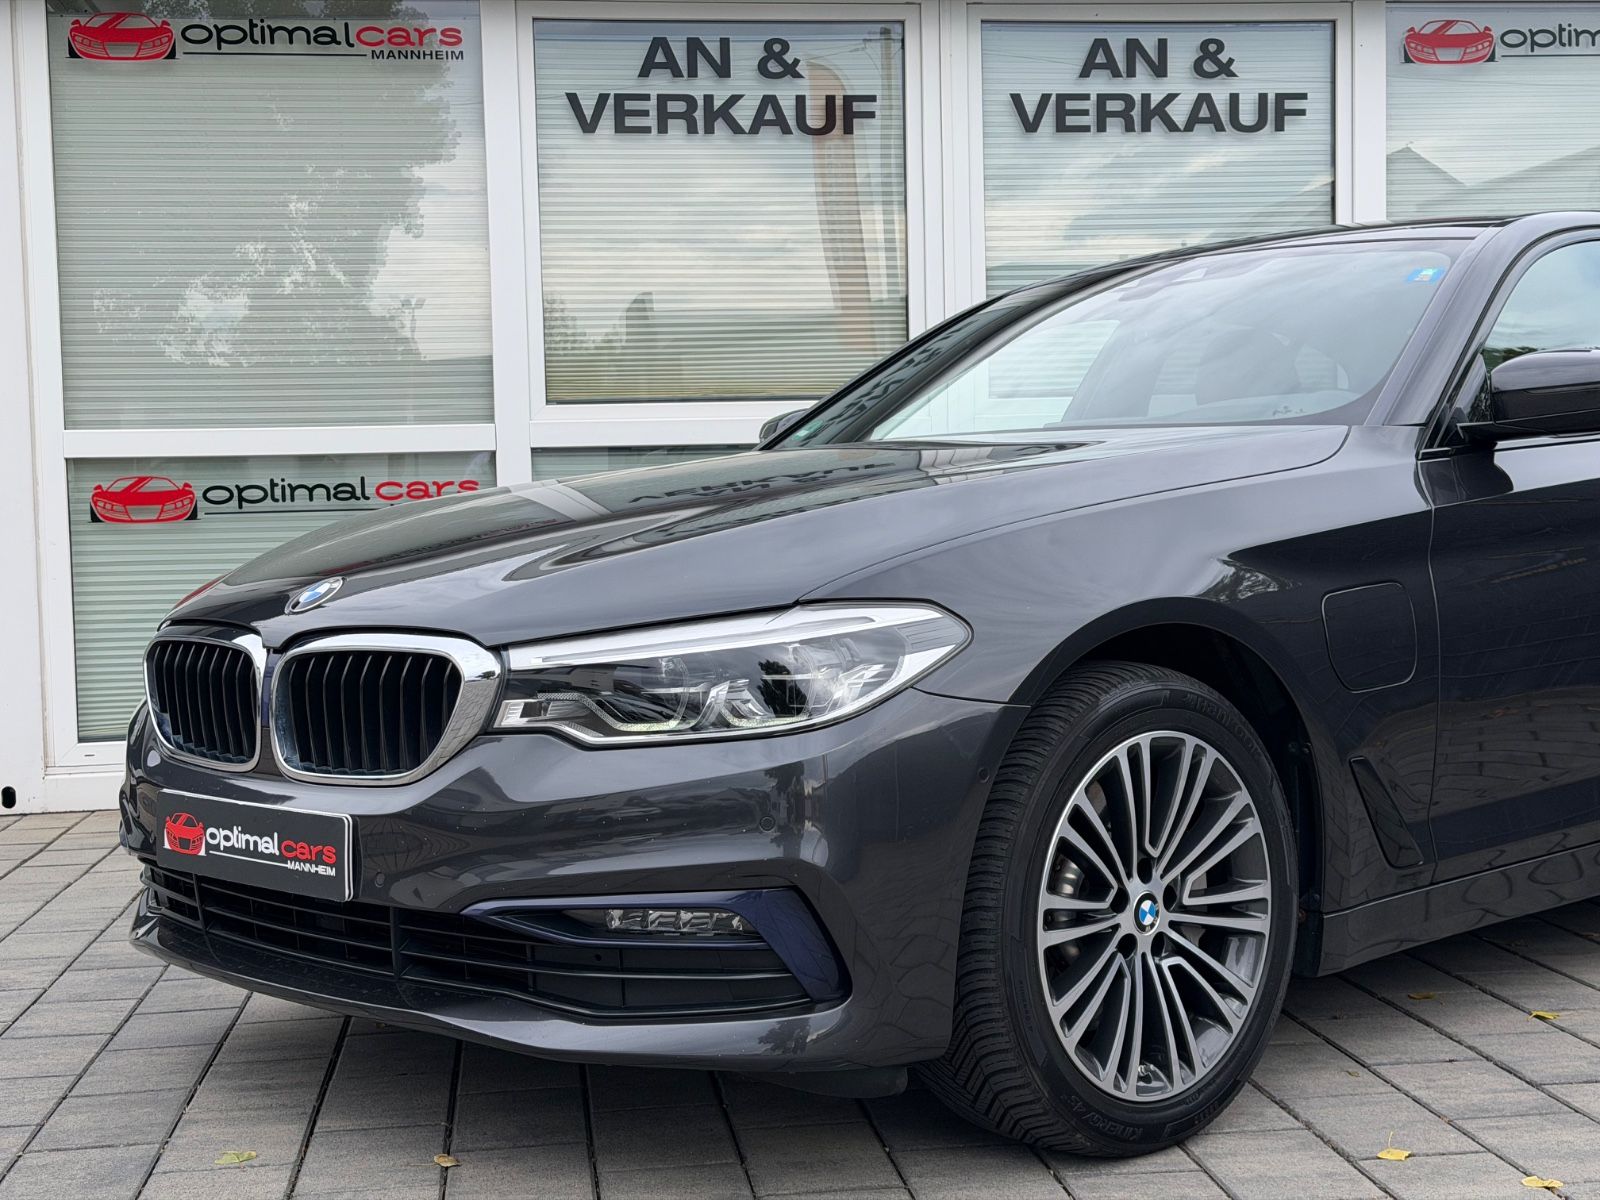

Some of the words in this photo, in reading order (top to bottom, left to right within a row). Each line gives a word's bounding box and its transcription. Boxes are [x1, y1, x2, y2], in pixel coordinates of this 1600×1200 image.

[371, 49, 464, 61] MANNHEIM
[637, 37, 732, 78] AN
[757, 37, 805, 79] &
[1078, 38, 1168, 78] AN
[1193, 38, 1239, 78] &
[565, 92, 877, 135] VERKAUF
[1009, 92, 1308, 133] VERKAUF
[287, 860, 335, 876] MANNHEIM
